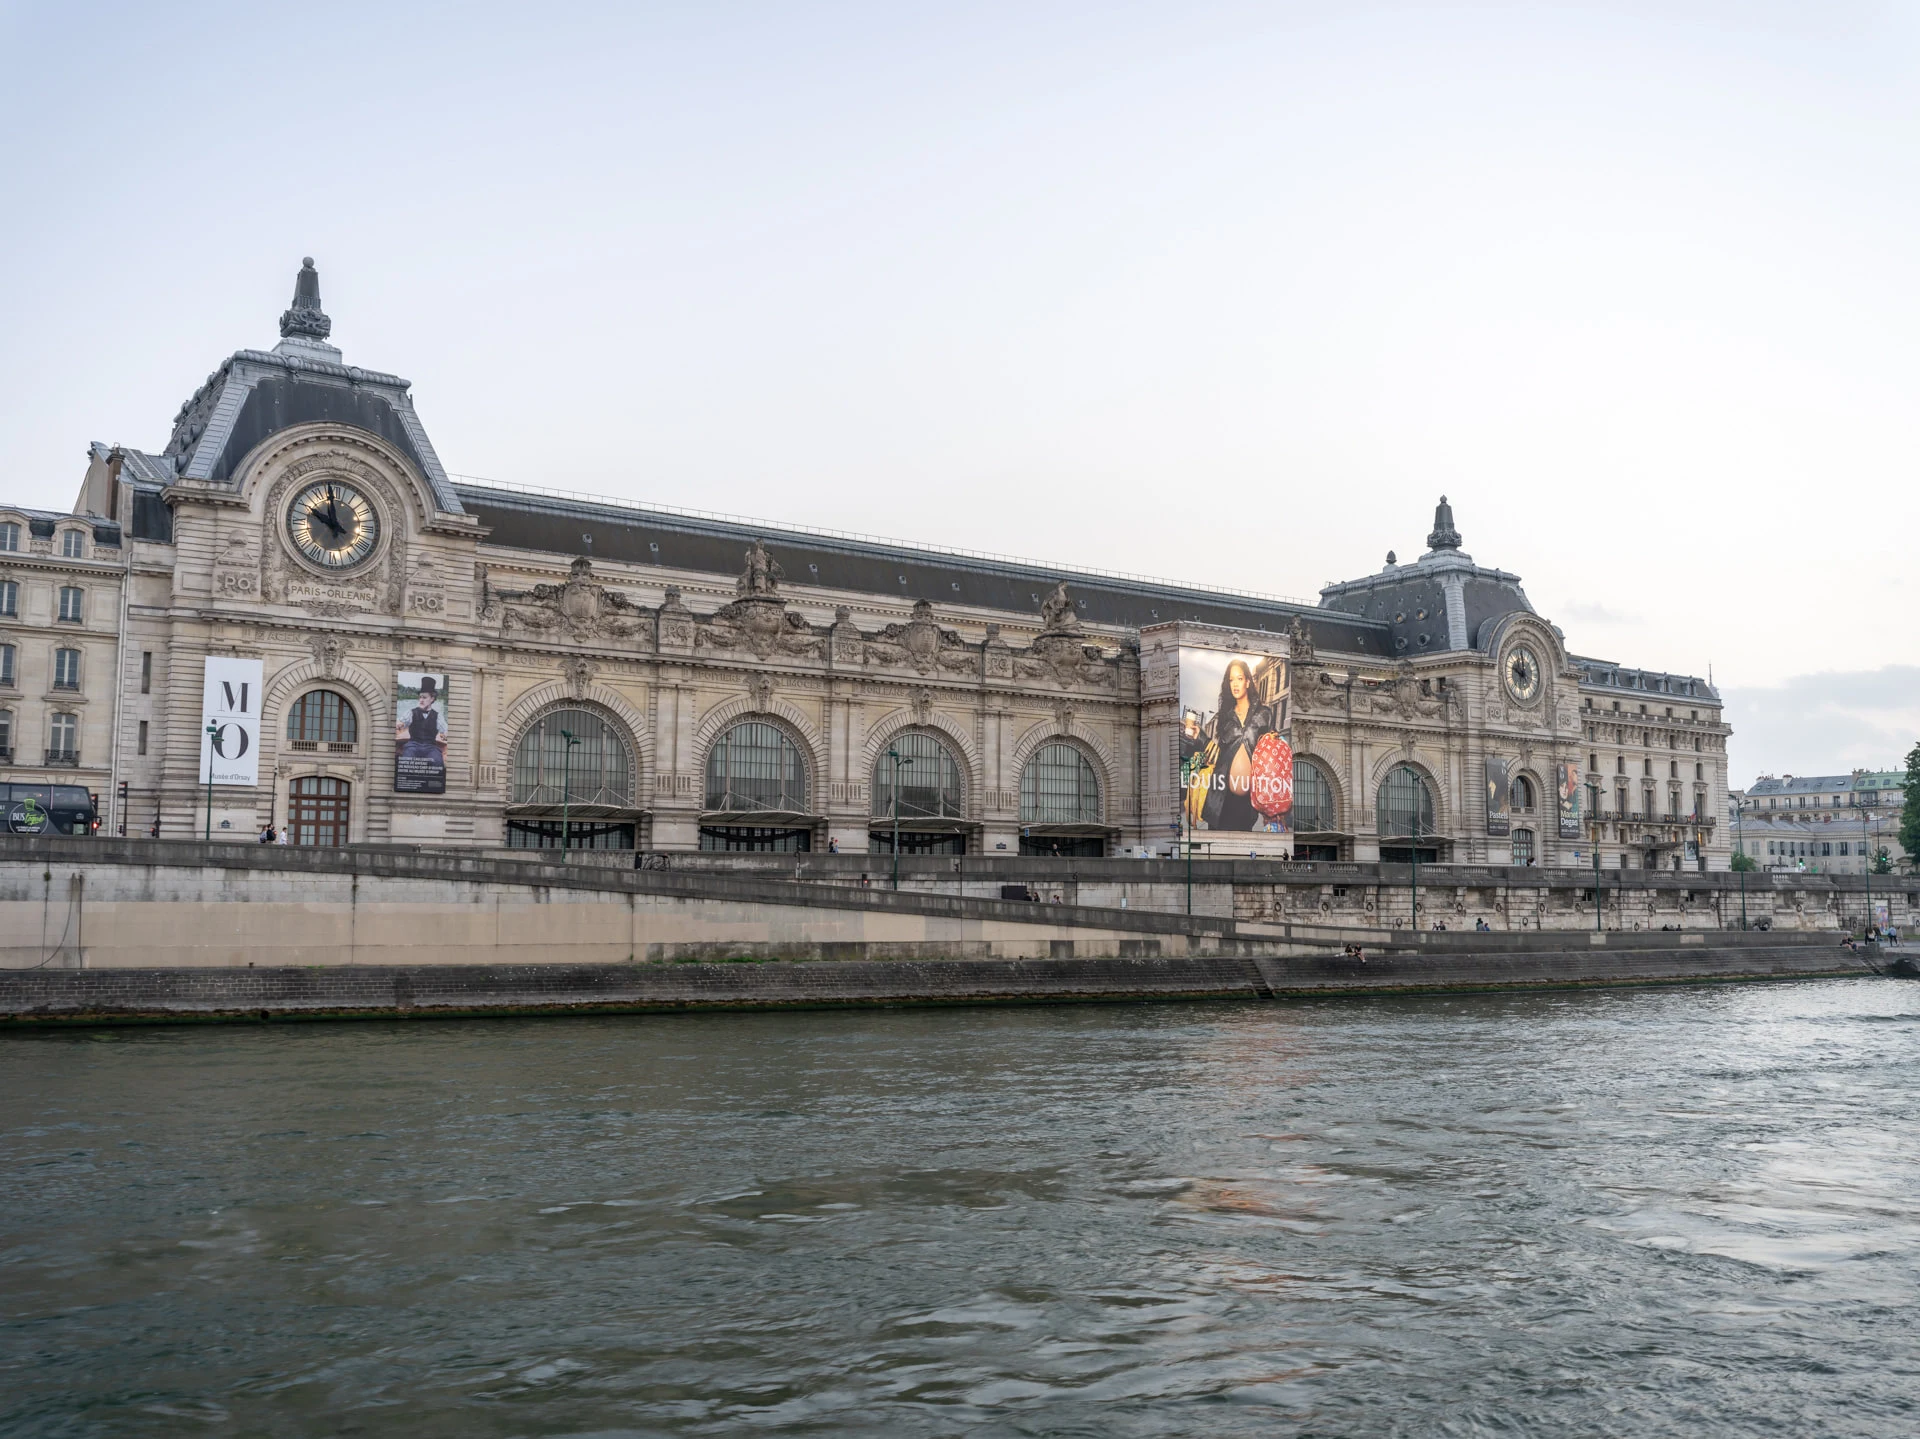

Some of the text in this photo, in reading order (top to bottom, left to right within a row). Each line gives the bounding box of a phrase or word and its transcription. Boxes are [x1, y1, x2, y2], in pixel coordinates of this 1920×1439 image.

[357, 508, 370, 517] II
[361, 525, 374, 534] III
[224, 576, 251, 590] PO
[414, 596, 437, 609] PO
[268, 631, 301, 643] AGEN
[217, 680, 251, 713] M
[213, 722, 249, 760] O
[1180, 771, 1293, 794] LOUIS VUITTON
[12, 812, 25, 821] BUS
